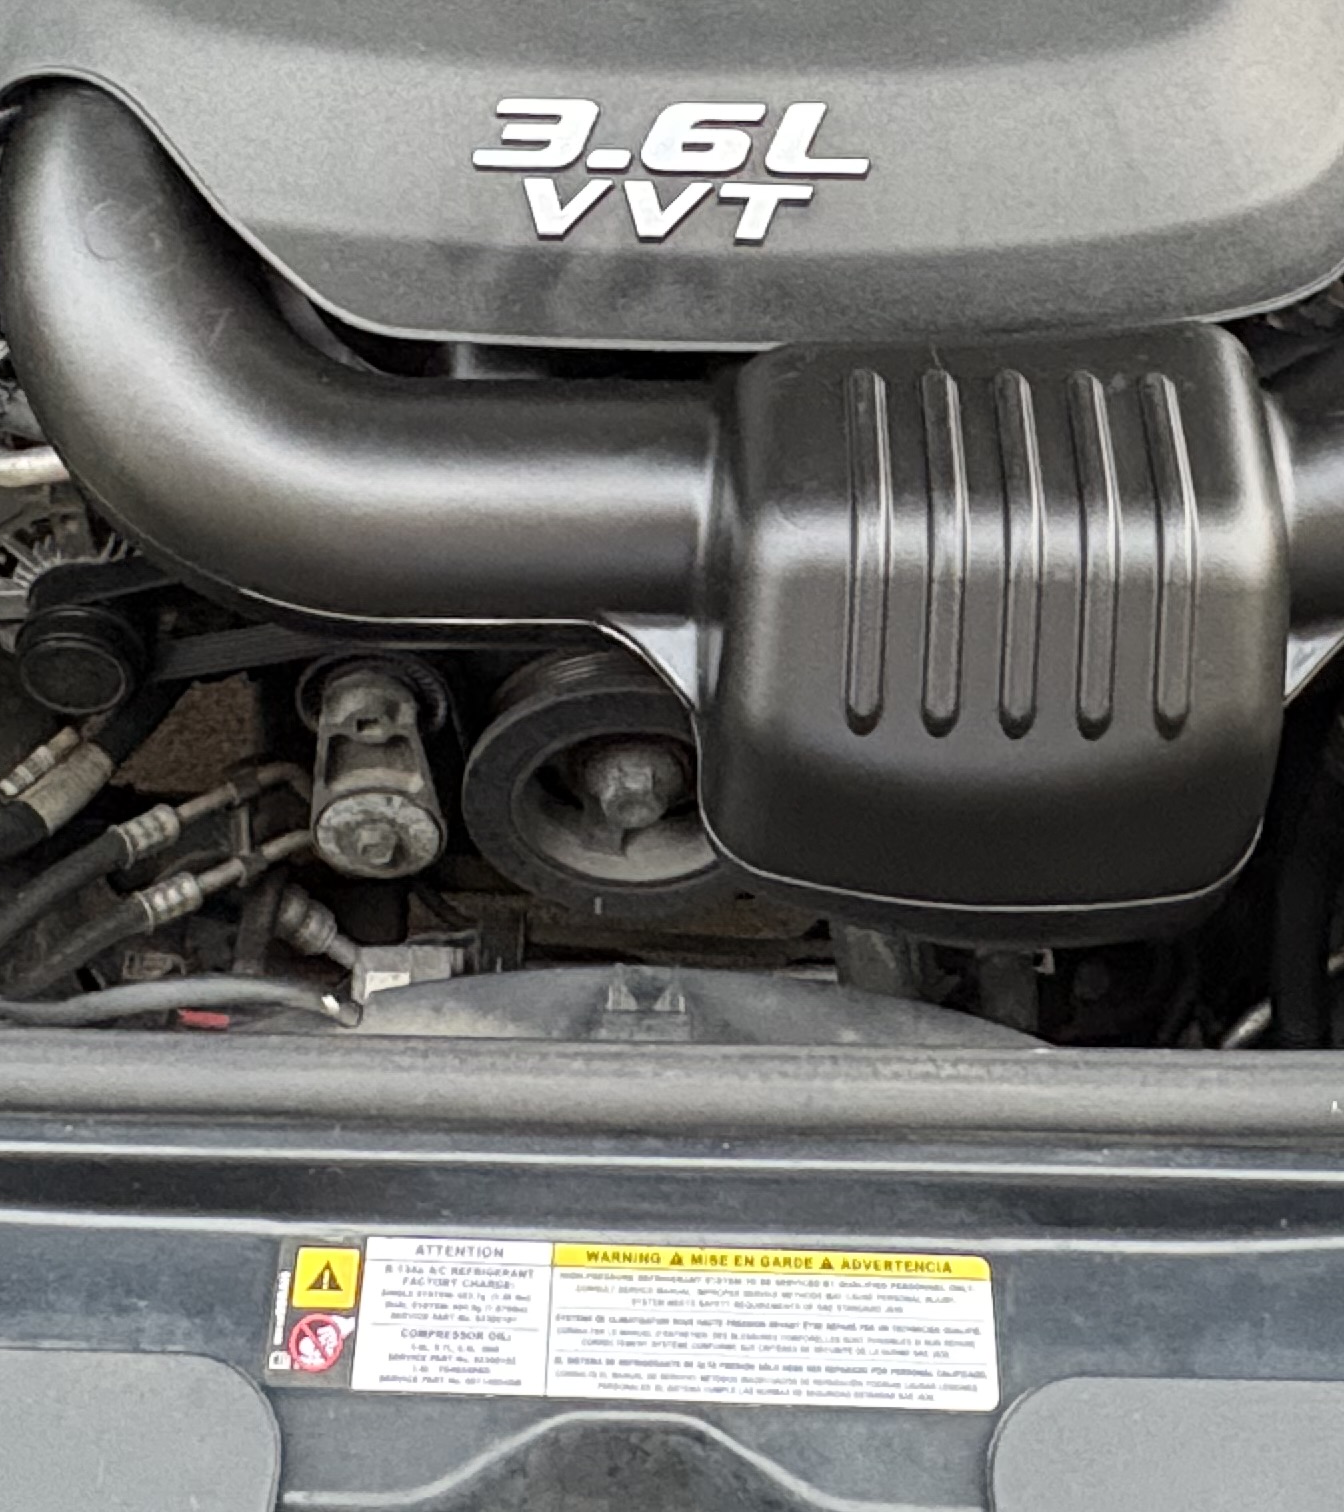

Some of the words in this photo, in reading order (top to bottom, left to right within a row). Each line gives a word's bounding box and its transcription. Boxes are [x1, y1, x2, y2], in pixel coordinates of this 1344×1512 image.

[471, 96, 872, 177] 3.6L
[521, 176, 814, 245] VVT
[414, 1244, 505, 1259] ATTENTION
[586, 1250, 661, 1265] WARNING
[690, 1253, 729, 1267] MISE
[734, 1254, 756, 1268] EN
[760, 1255, 814, 1270] GARDE
[840, 1257, 953, 1274] ADVERTENCIA
[451, 1267, 535, 1280] REFRIGERANT
